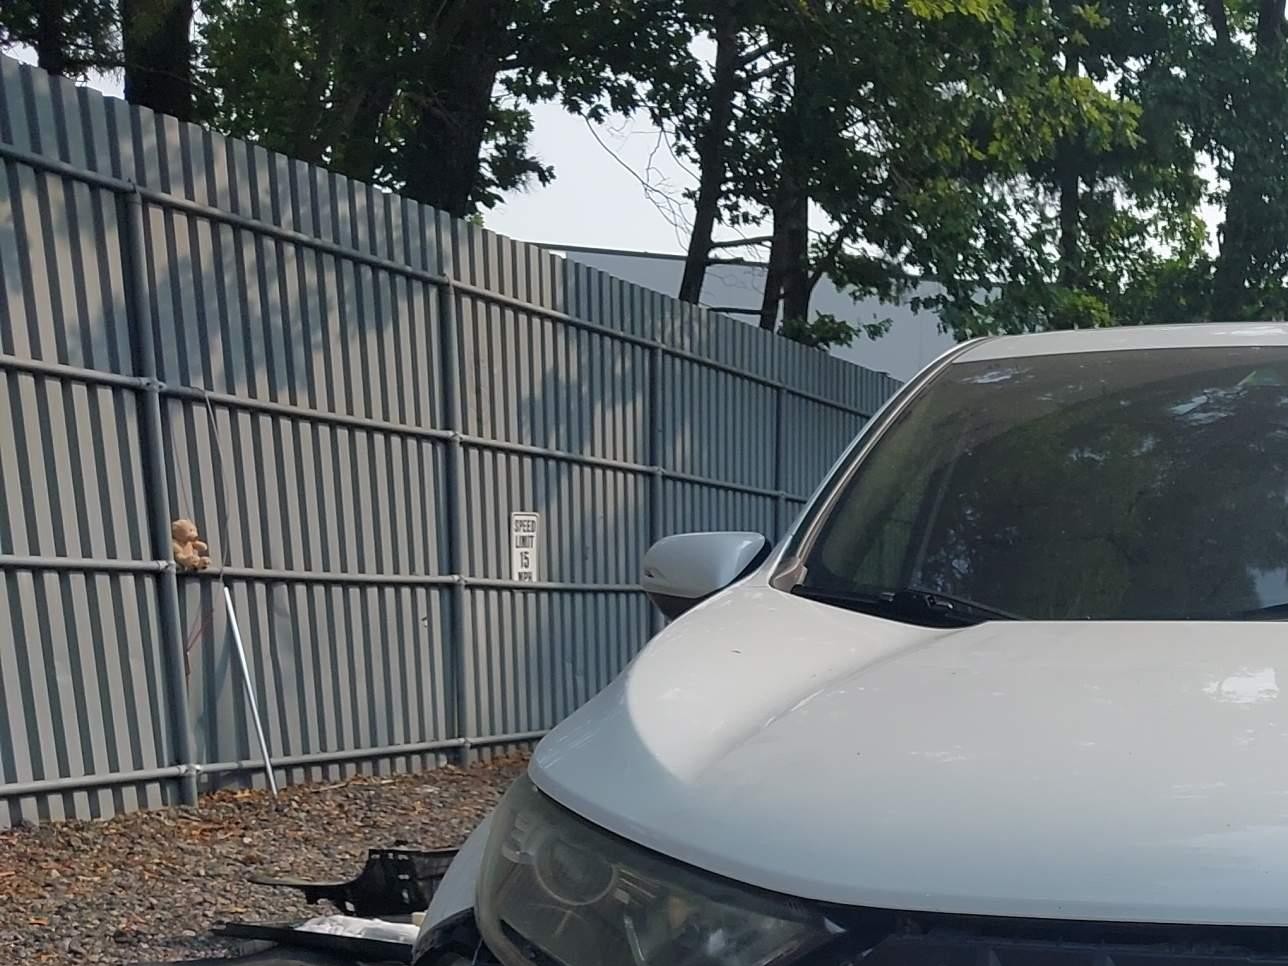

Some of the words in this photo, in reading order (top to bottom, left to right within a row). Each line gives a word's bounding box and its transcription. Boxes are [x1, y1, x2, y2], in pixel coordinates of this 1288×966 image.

[514, 519, 536, 533] SPEED
[515, 535, 535, 548] LIMIT
[519, 551, 530, 569] 15
